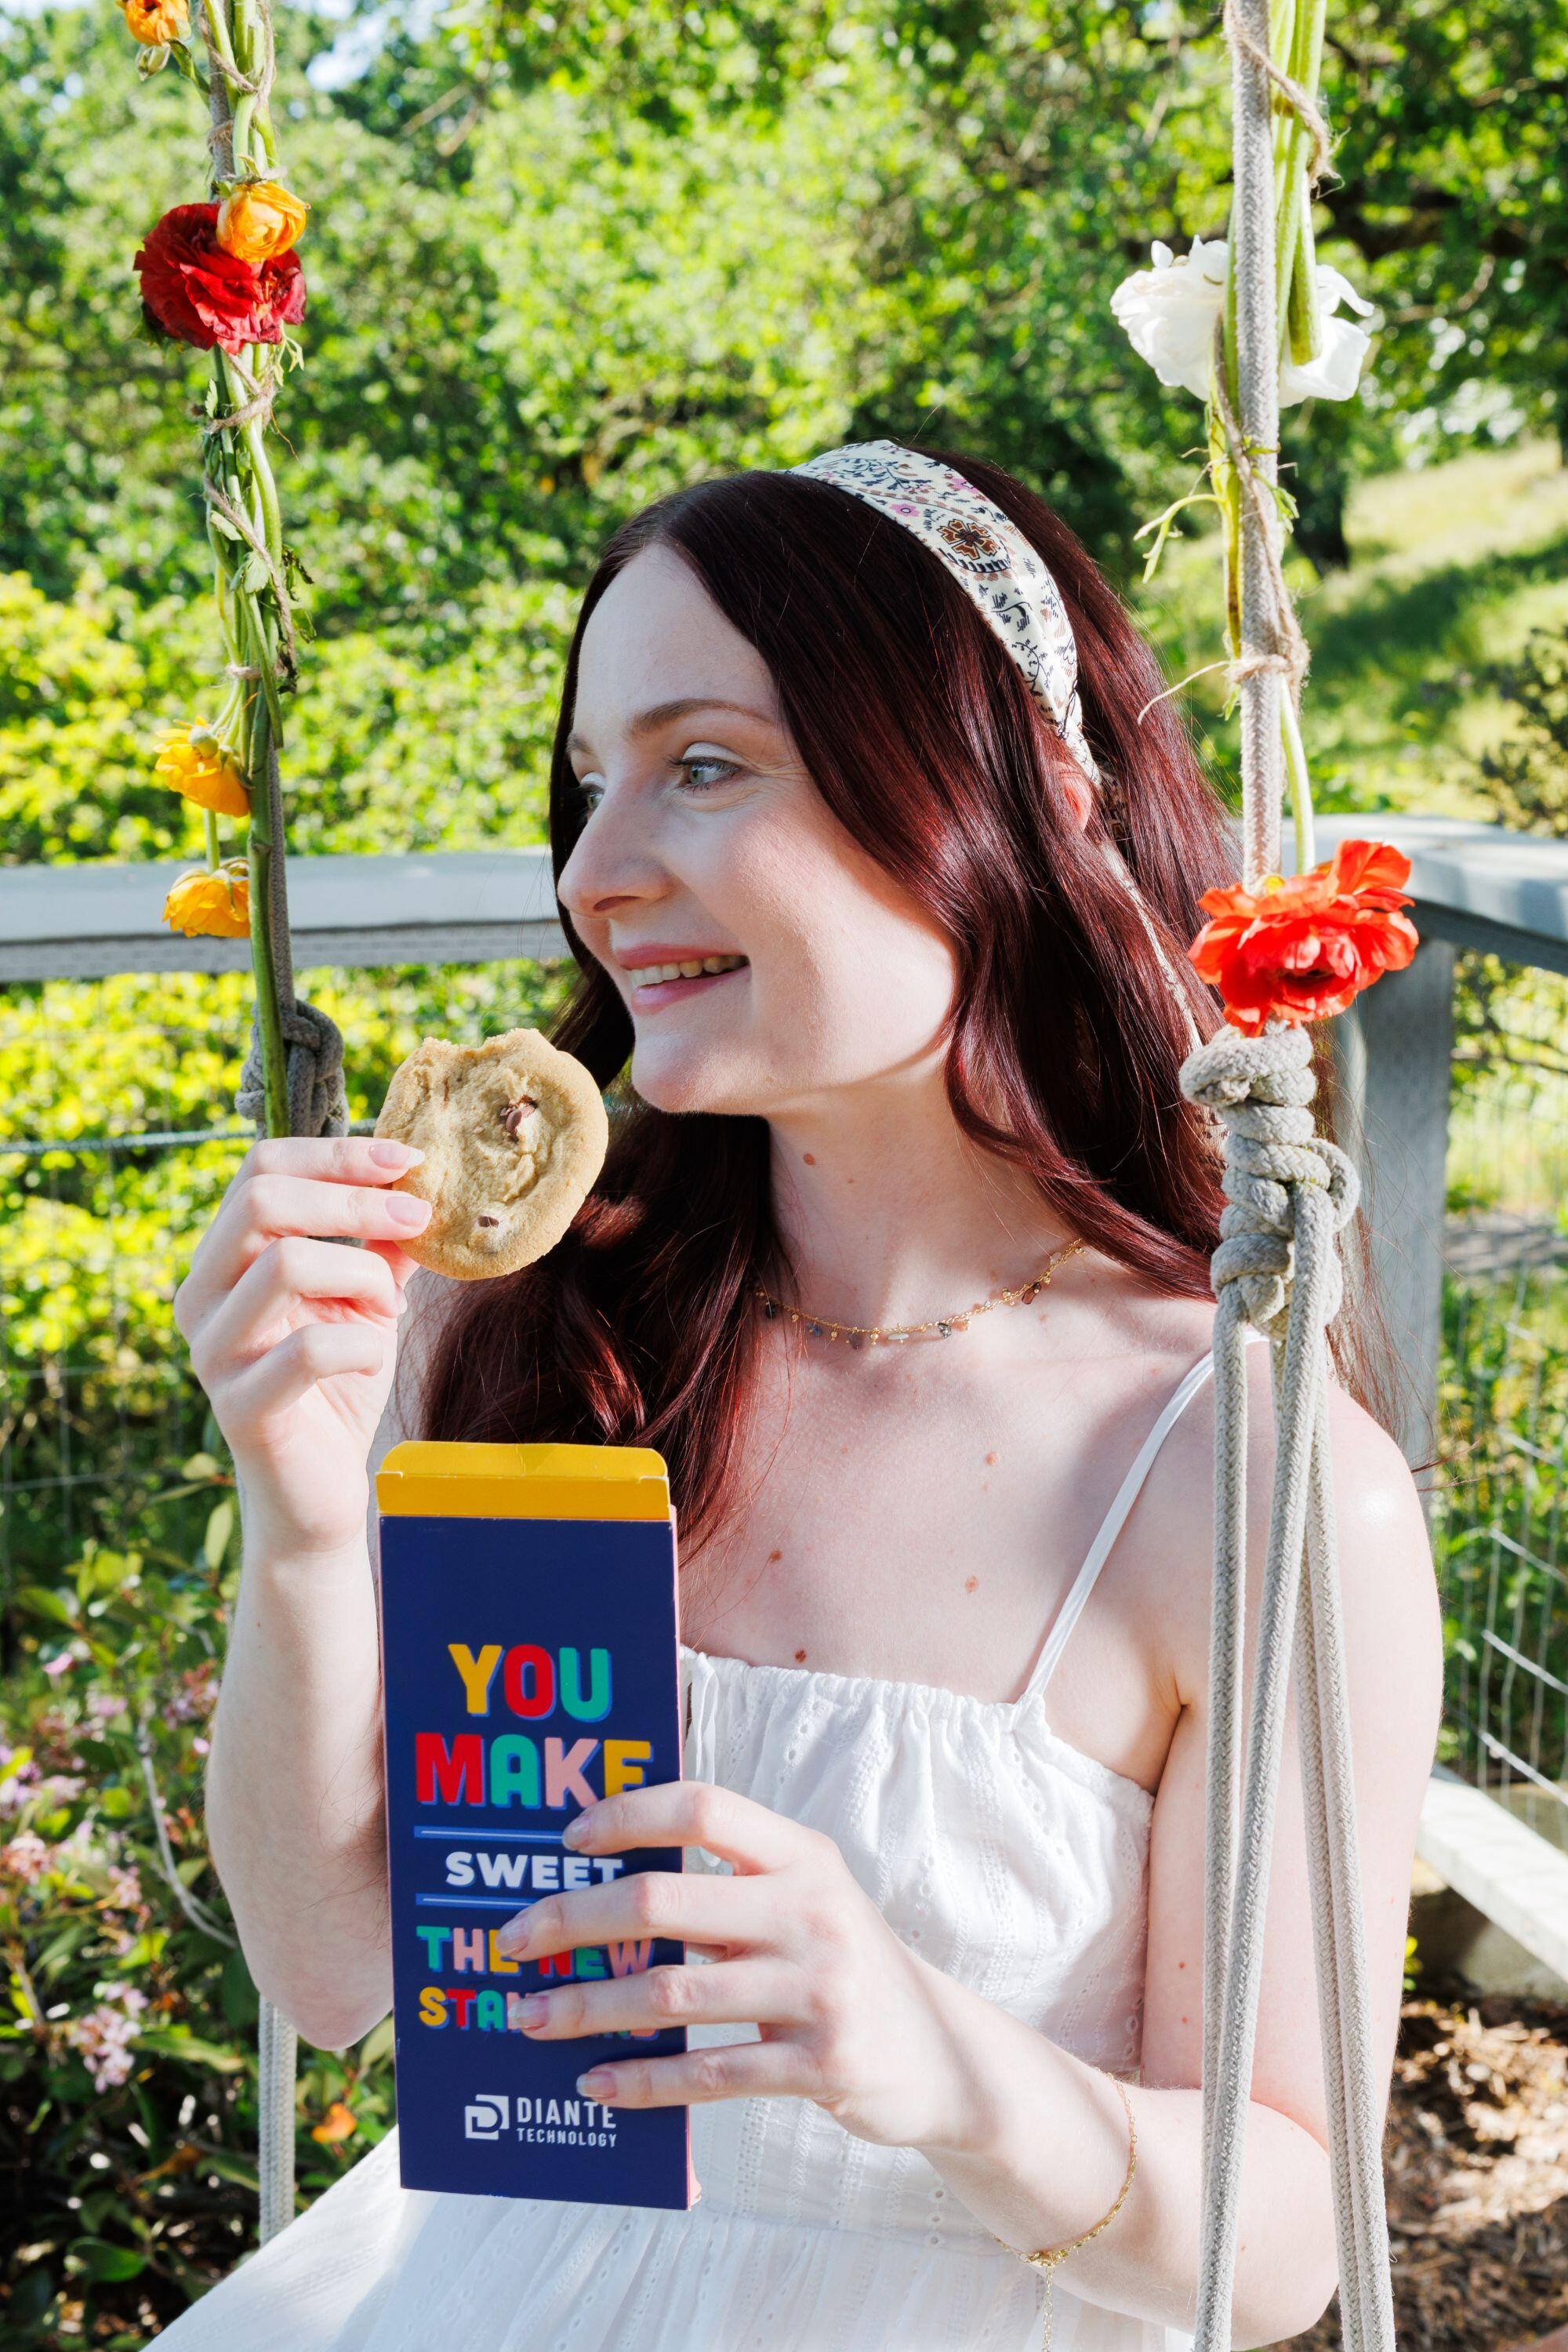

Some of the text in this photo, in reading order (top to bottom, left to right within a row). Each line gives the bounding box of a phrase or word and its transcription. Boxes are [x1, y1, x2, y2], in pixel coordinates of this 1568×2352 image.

[448, 1643, 612, 1722] YOU
[415, 1733, 655, 1810] MAKE
[445, 1851, 625, 1889] SWEET
[416, 1926, 521, 1976] THE
[516, 2096, 617, 2129] DIANTE
[516, 2128, 617, 2148] TECHNOLOGY
